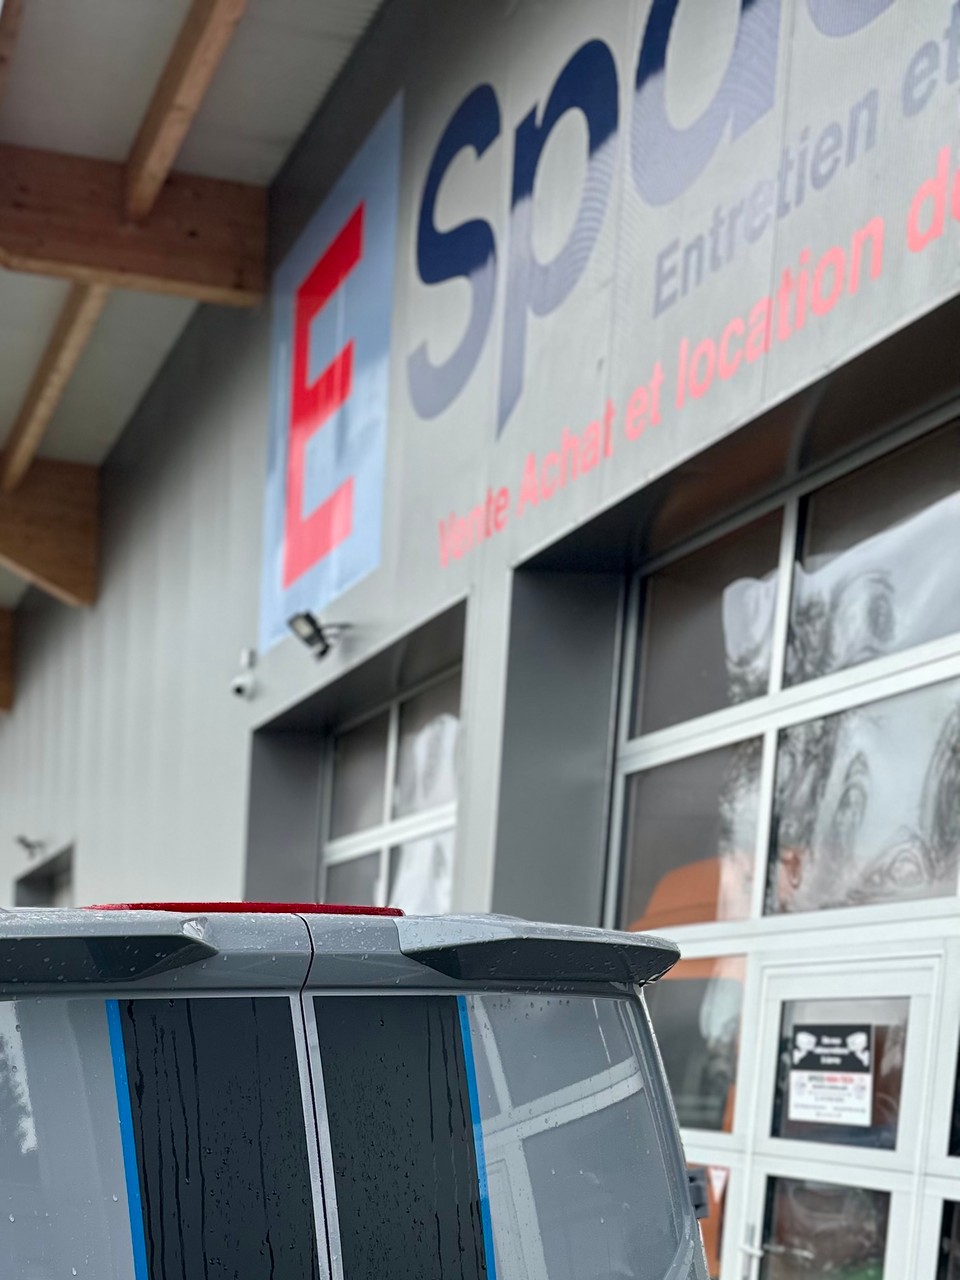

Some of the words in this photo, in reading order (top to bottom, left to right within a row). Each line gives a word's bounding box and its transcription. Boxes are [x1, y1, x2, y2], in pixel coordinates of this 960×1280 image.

[438, 486, 509, 569] Vente
[515, 398, 616, 518] Achat
[624, 361, 664, 442] et
[674, 216, 885, 411] location
[906, 145, 960, 254] d
[653, 88, 880, 320] Entretien
